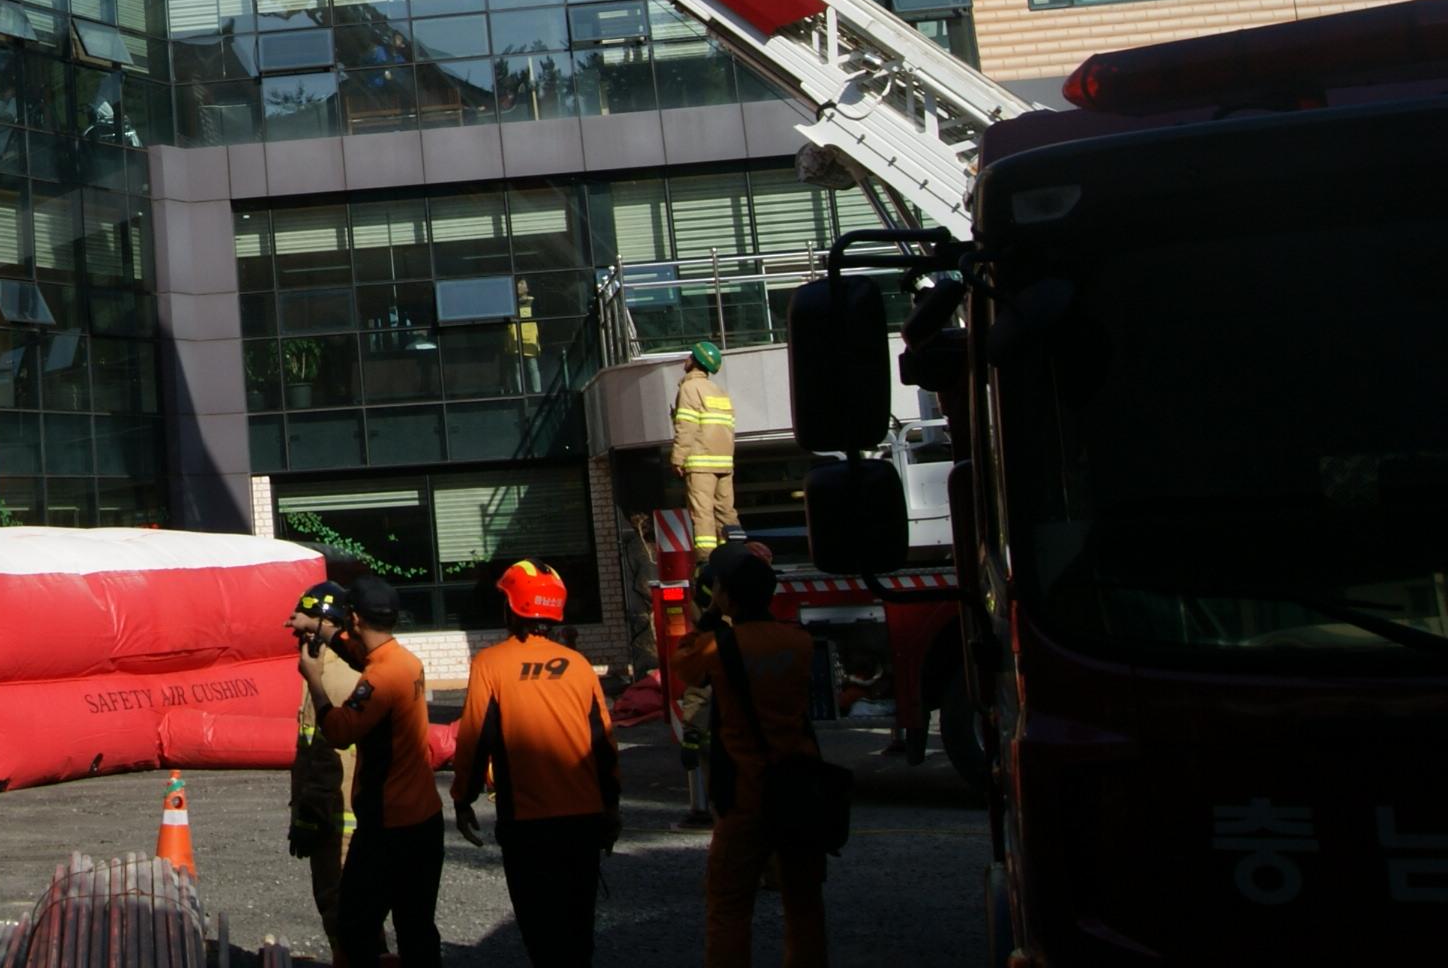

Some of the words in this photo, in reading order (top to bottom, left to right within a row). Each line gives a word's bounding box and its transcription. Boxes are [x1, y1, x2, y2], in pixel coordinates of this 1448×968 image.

[519, 657, 570, 681] 119
[84, 688, 154, 714] SAFETY
[160, 685, 188, 707] AIR
[191, 677, 259, 703] CUSHION
